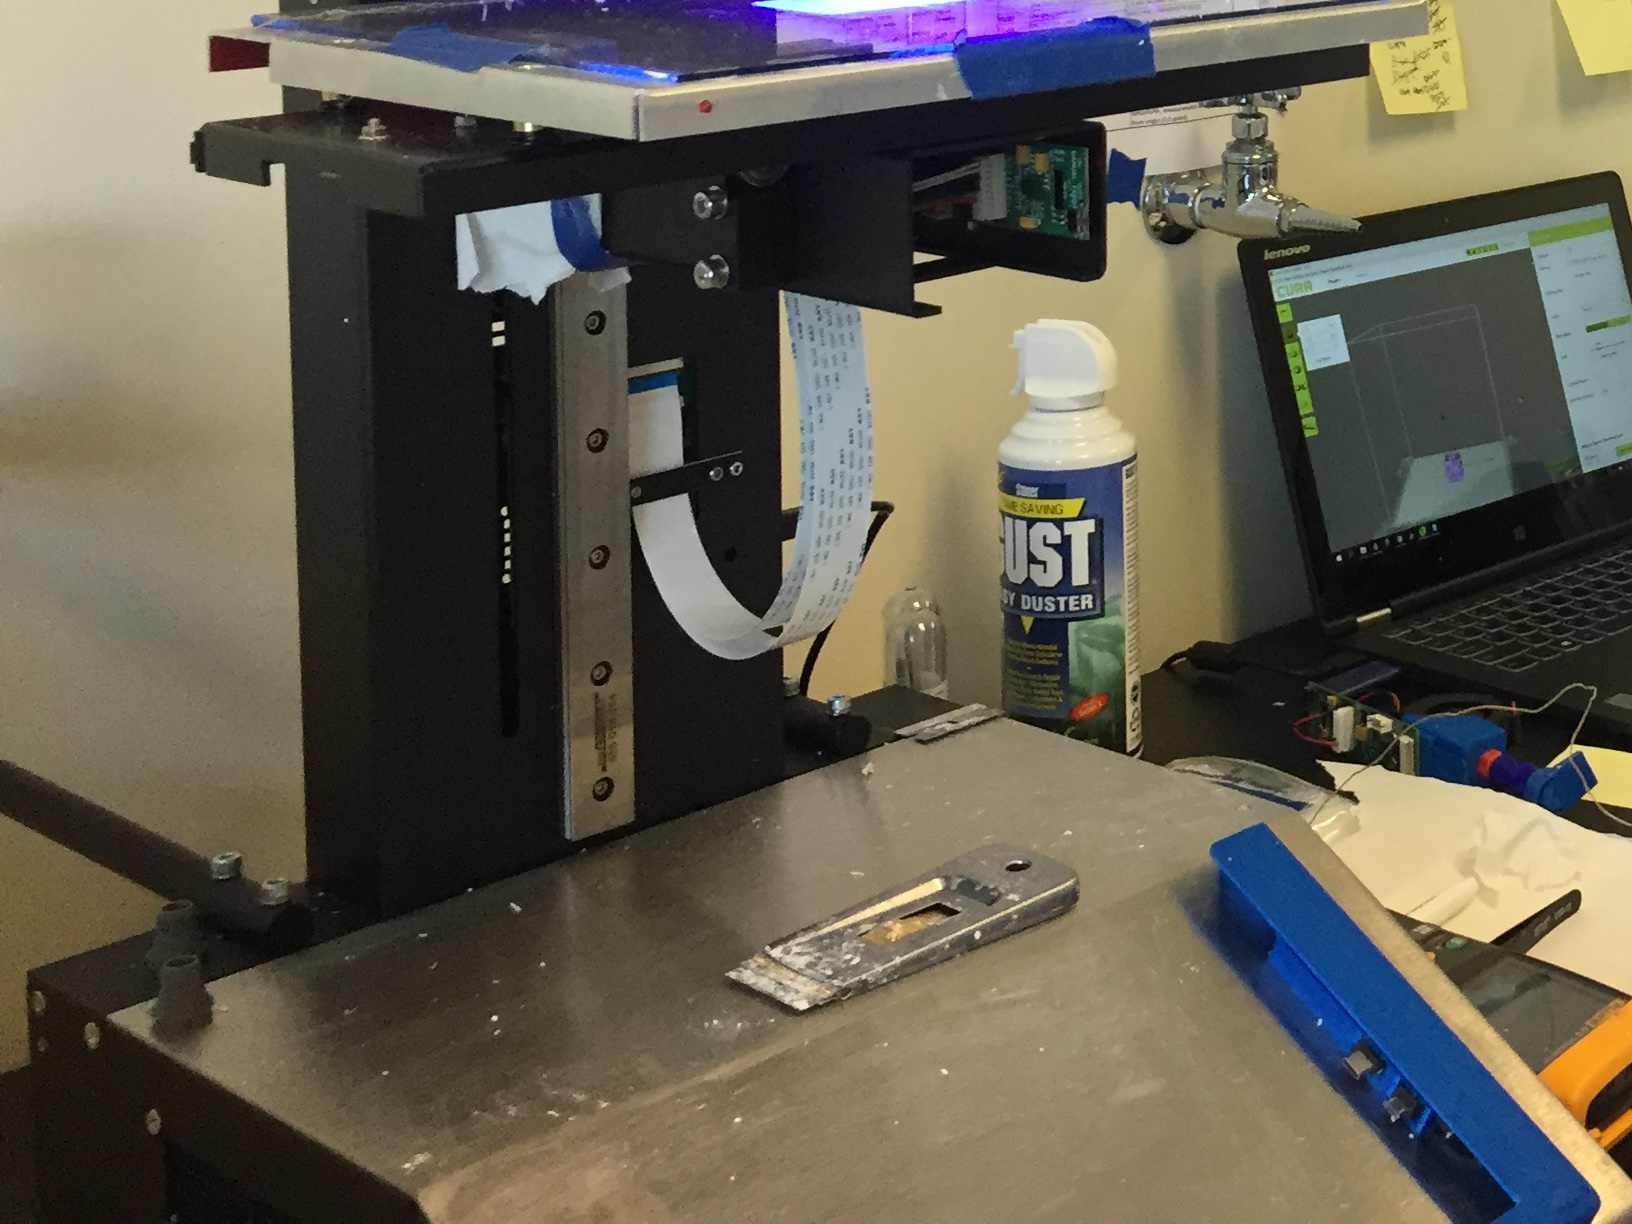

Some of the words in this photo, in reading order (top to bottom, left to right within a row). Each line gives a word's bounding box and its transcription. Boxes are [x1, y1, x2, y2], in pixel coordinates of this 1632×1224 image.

[1264, 244, 1312, 261] lenovo
[1020, 503, 1065, 516] SAVING
[1001, 516, 1097, 588] UST
[1021, 593, 1094, 613] DUSTER
